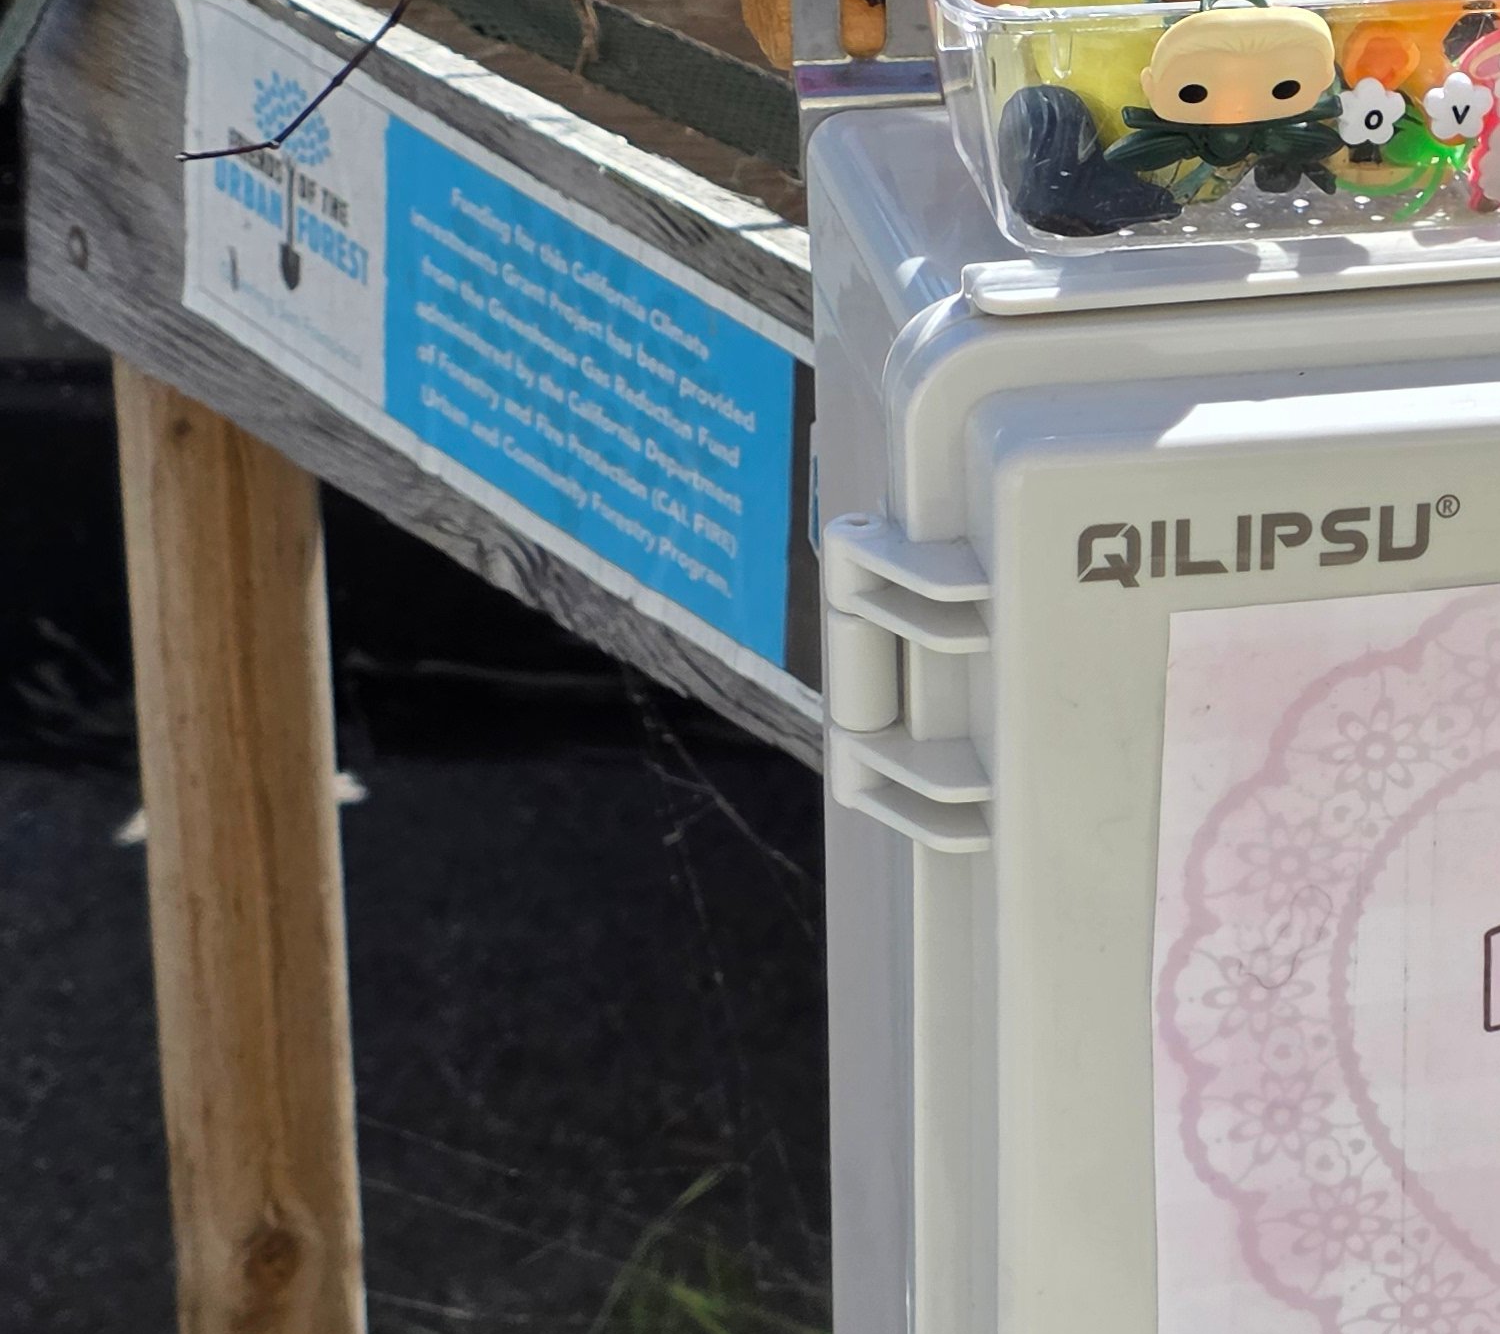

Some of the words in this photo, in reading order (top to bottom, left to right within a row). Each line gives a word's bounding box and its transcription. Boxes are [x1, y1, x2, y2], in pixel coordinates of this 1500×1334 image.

[213, 156, 283, 230] URBAN
[296, 205, 369, 287] FOREST
[571, 261, 647, 323] California
[567, 390, 642, 453] California
[645, 437, 742, 516] Department
[580, 355, 611, 390] Gas
[614, 374, 693, 441] Reduction
[698, 424, 741, 469] Fund
[679, 376, 756, 434] provided
